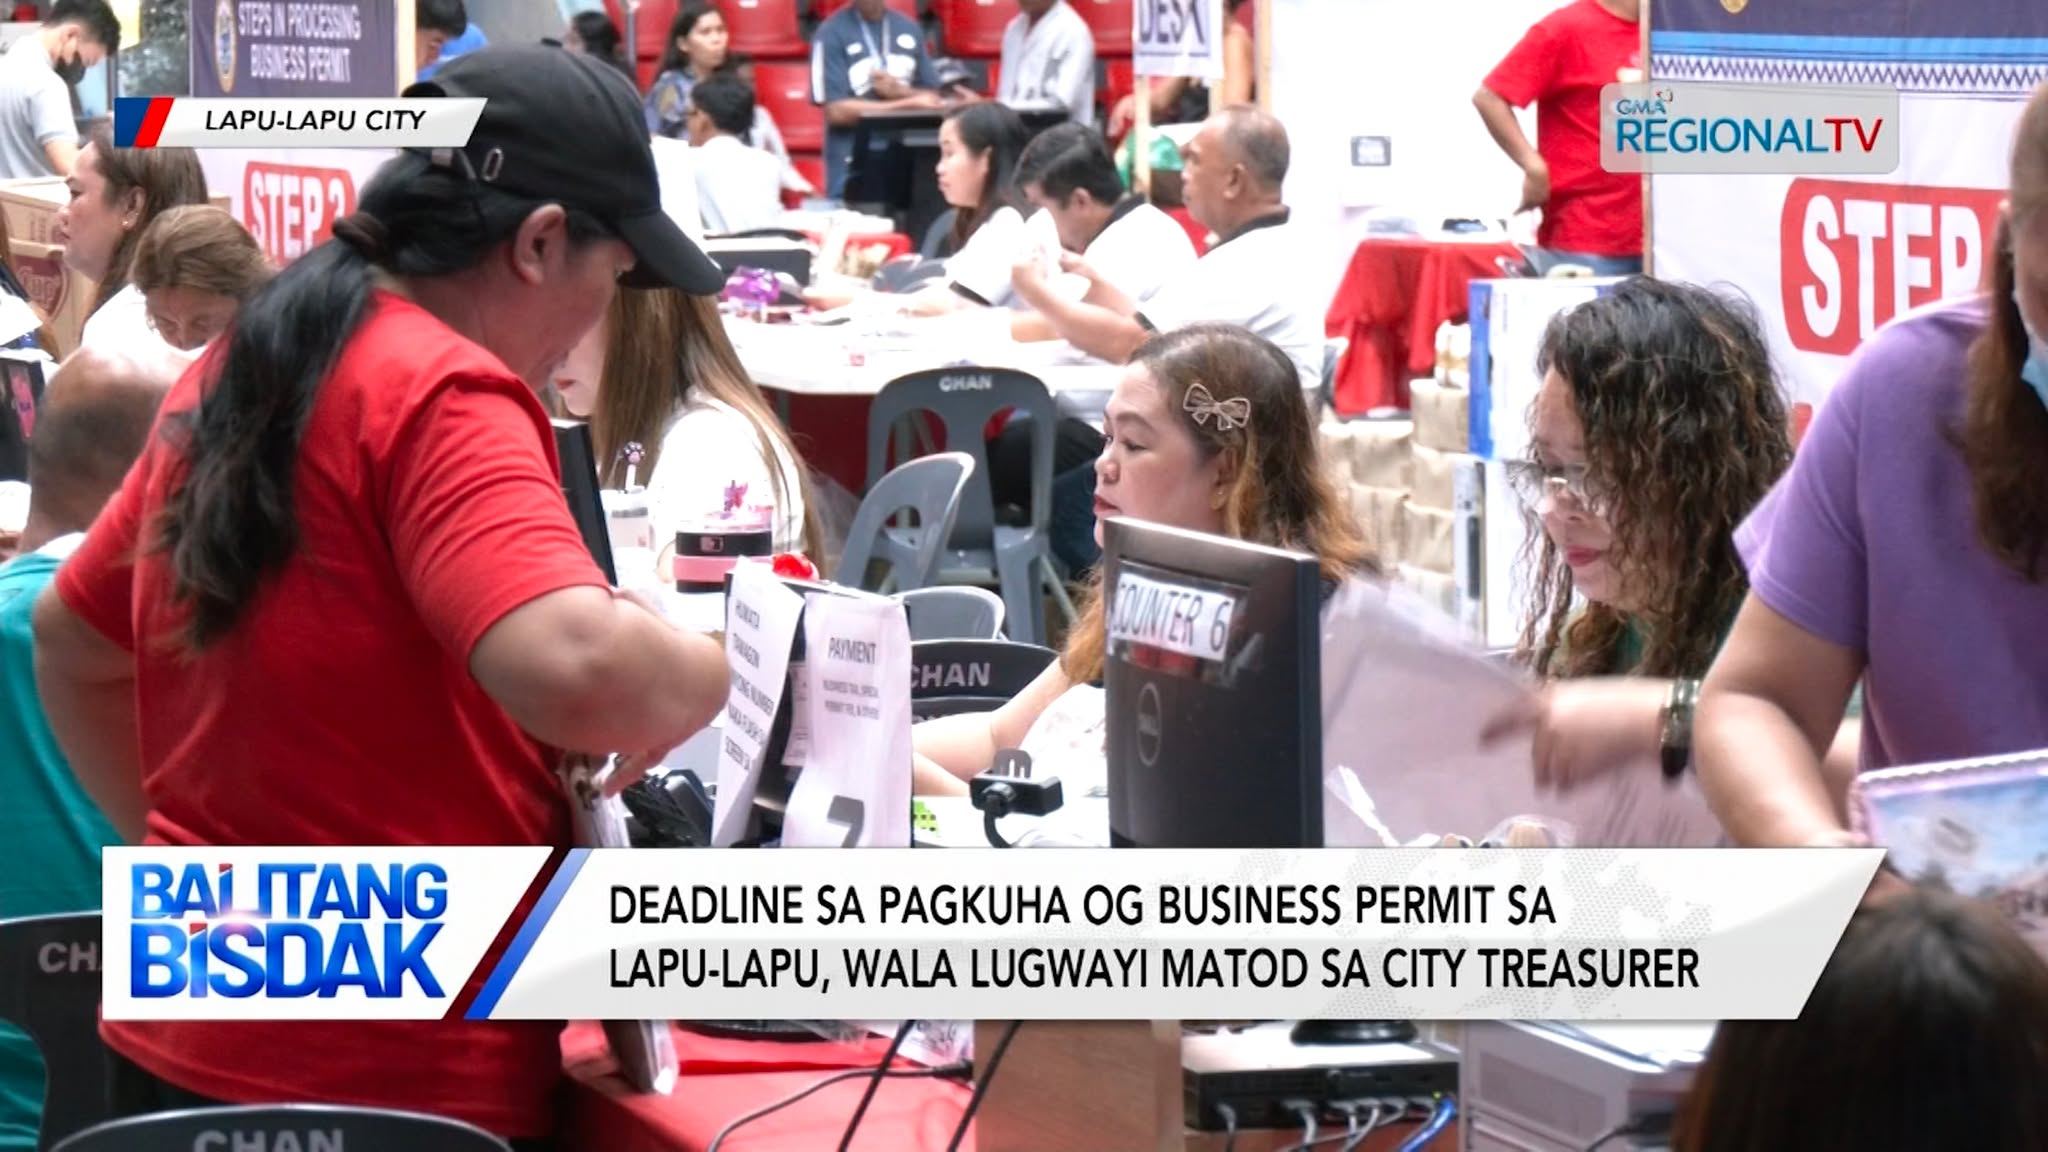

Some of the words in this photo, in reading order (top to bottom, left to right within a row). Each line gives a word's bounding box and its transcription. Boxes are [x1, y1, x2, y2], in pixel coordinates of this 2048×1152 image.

[238, 1, 272, 37] STEPS
[273, 3, 286, 37] IN
[288, 4, 362, 40] PROCESSING
[251, 44, 306, 80] BUSINESS
[308, 46, 350, 83] PERMIT
[250, 170, 324, 262] STEP
[1801, 194, 1983, 339] STEP
[939, 373, 993, 393] CHAN
[1109, 583, 1204, 647] COUNTER
[1209, 600, 1231, 652] 6
[827, 637, 877, 665] PAYMENT
[827, 794, 865, 848] 7
[38, 941, 102, 973] CH
[194, 1128, 344, 1152] CHAN
